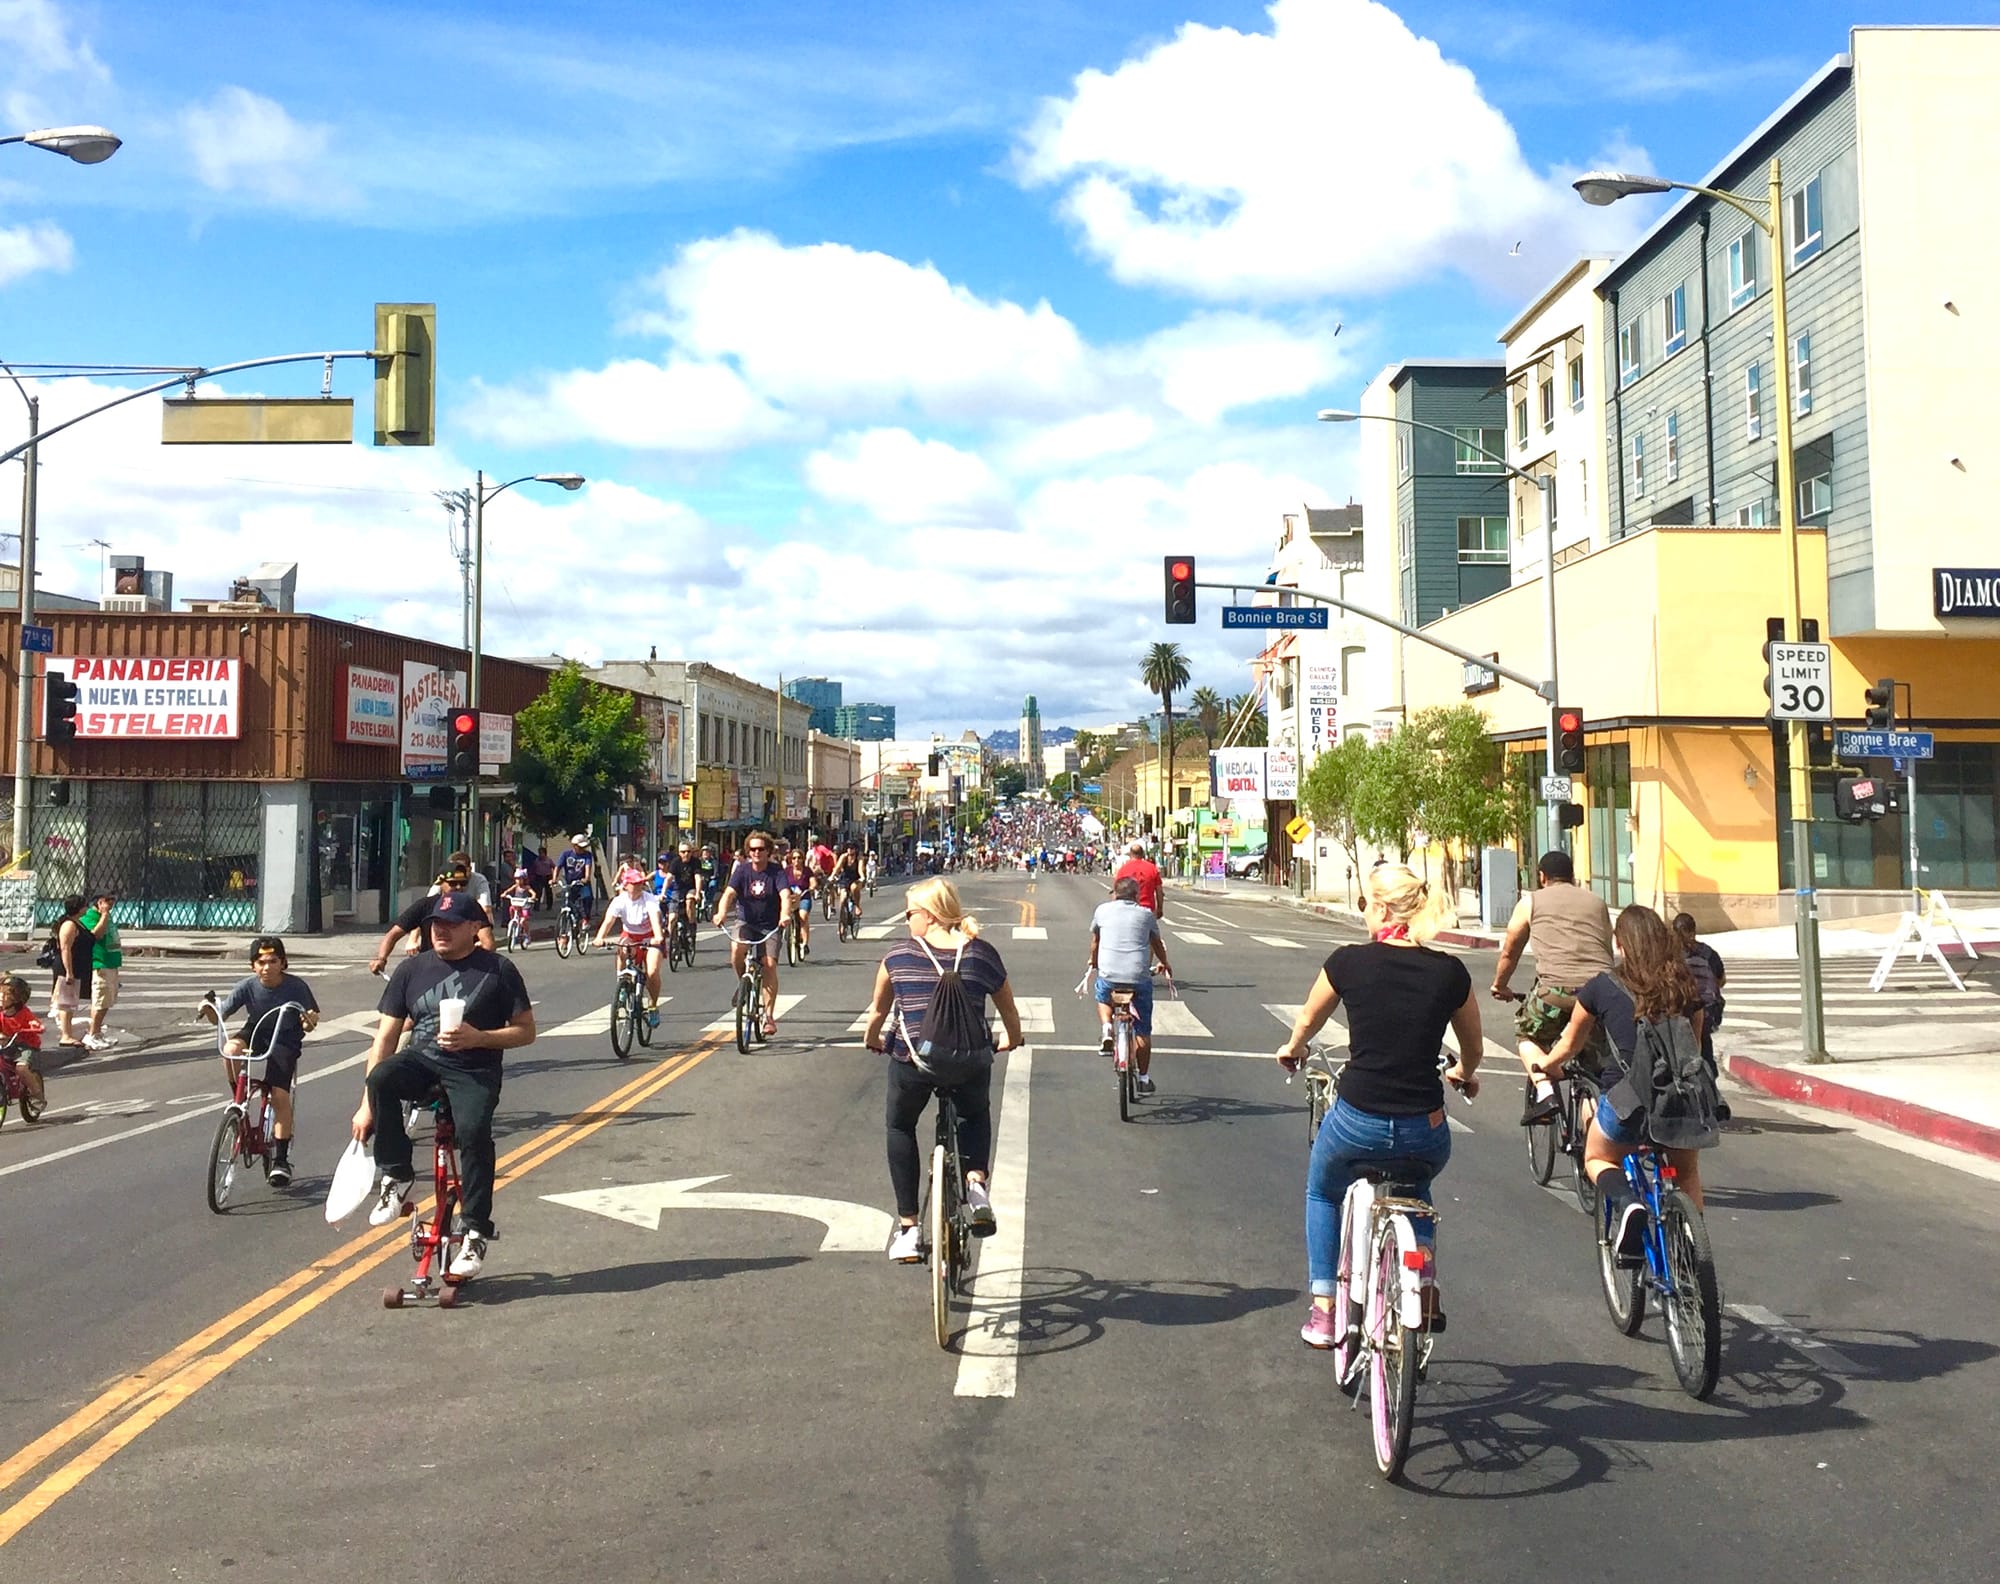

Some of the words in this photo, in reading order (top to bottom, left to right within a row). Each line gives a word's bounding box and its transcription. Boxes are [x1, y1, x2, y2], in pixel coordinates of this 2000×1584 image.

[1228, 611, 1272, 623] Bonnie
[1276, 612, 1304, 624] Brae
[1309, 612, 1322, 624] St
[41, 633, 51, 647] St
[1776, 650, 1826, 662] SPEED
[72, 658, 230, 681] PANADERIA
[1781, 667, 1821, 680] LIMIT
[351, 672, 395, 694] PANADERIA
[1330, 673, 1337, 682] 7
[88, 688, 139, 706] NUEVA
[144, 689, 228, 706] ESTRELLA
[1780, 684, 1825, 712] 30
[74, 713, 228, 735] ASTELERIA
[350, 720, 395, 738] PASTELERIA
[1842, 733, 1883, 745] Bonnie
[1888, 734, 1918, 747] Brae
[1843, 745, 1860, 754] 600
[1863, 745, 1869, 754] S
[1921, 748, 1930, 757] St
[1270, 754, 1295, 763] CLINICA
[1225, 761, 1258, 776] MEDICAL
[1270, 765, 1288, 774] CALLE
[1290, 763, 1297, 774] 7
